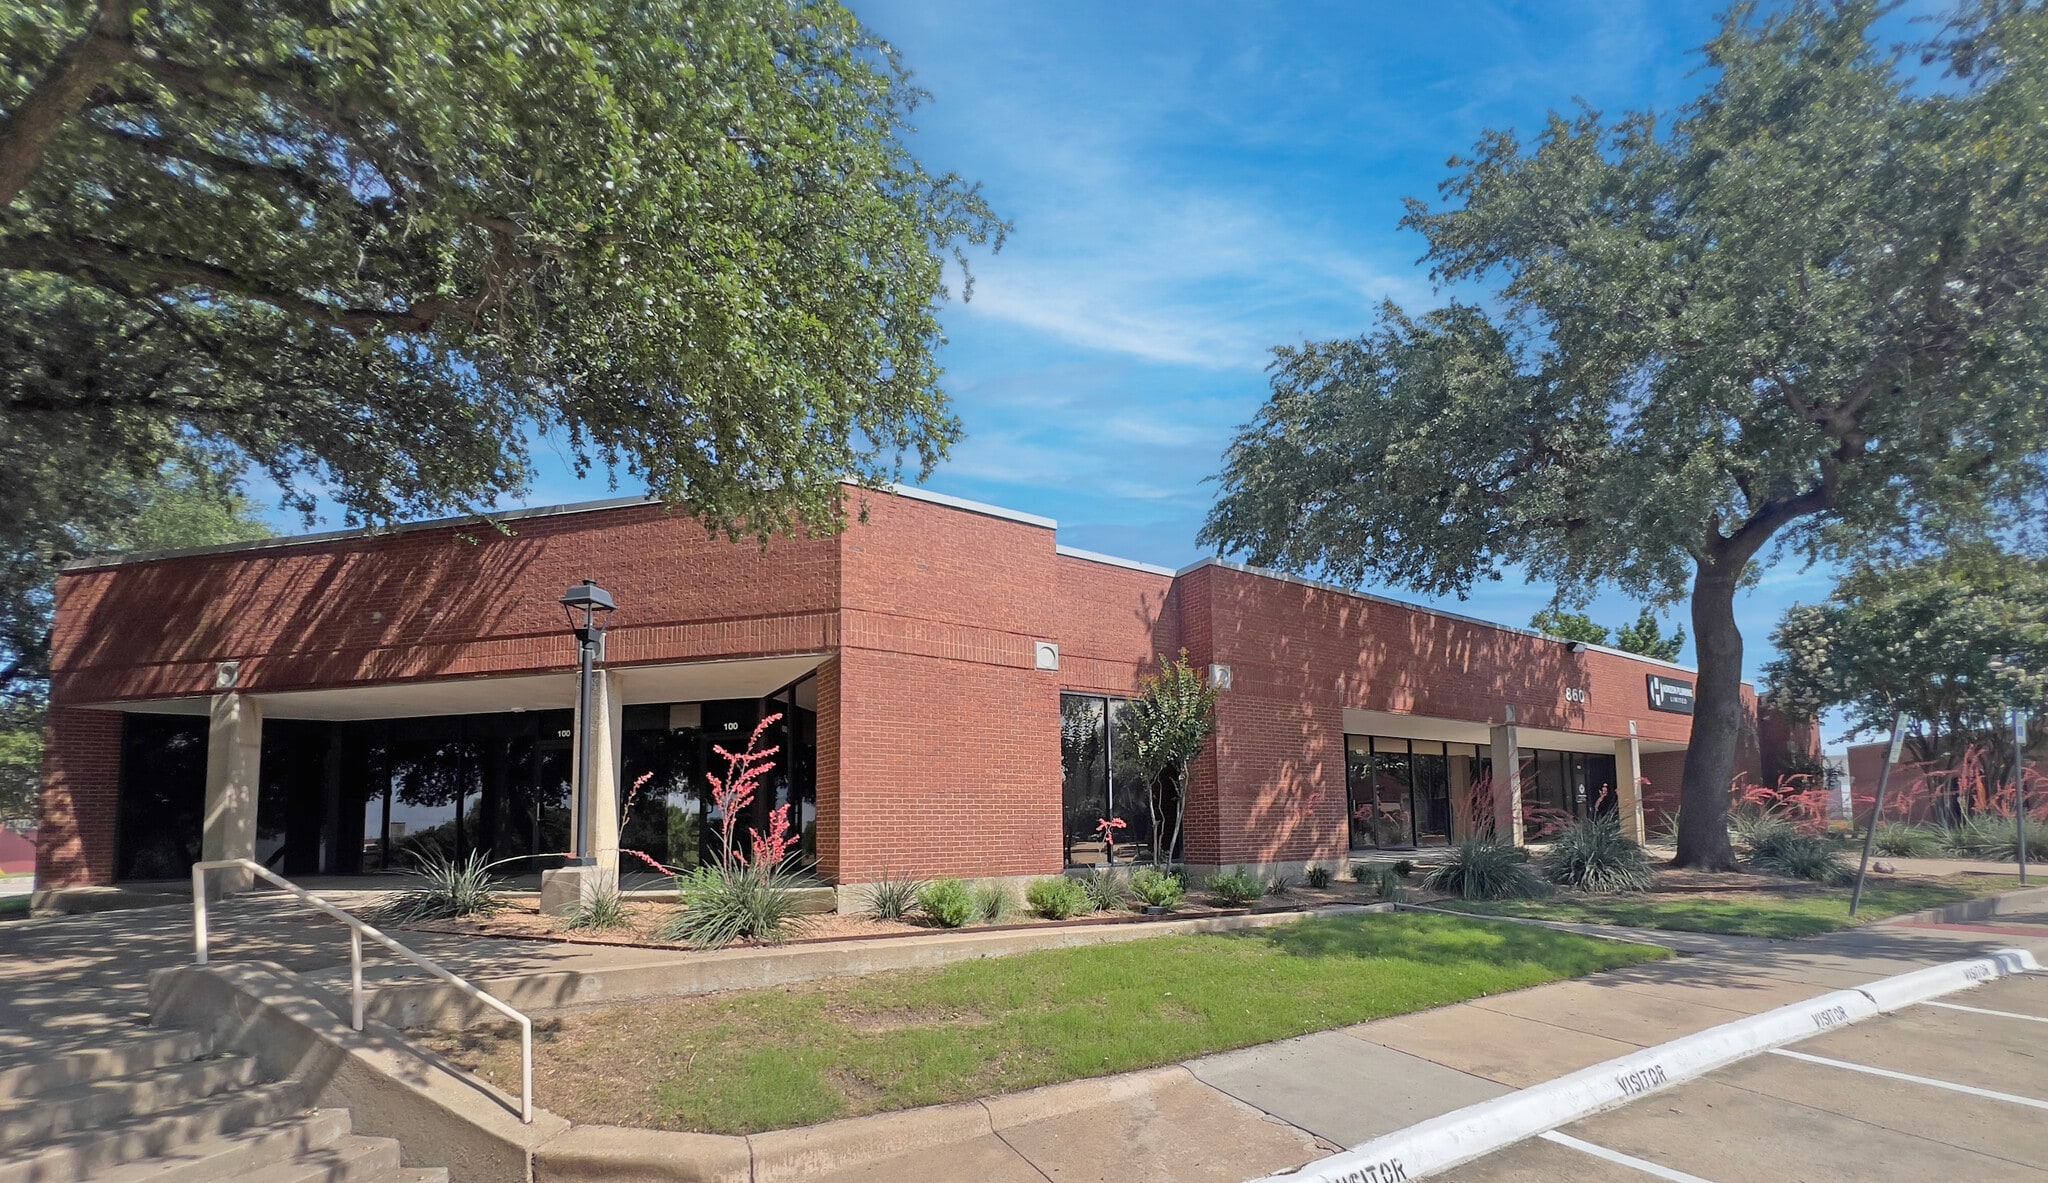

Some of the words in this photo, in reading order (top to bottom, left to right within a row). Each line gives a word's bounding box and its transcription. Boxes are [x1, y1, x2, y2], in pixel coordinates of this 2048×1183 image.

[1565, 687, 1585, 703] 860
[557, 730, 571, 738] 100
[722, 722, 739, 731] 100
[1963, 964, 1991, 981] VISITOR
[1811, 1006, 1849, 1028] VISITOR
[1617, 1064, 1667, 1097] VISITOR
